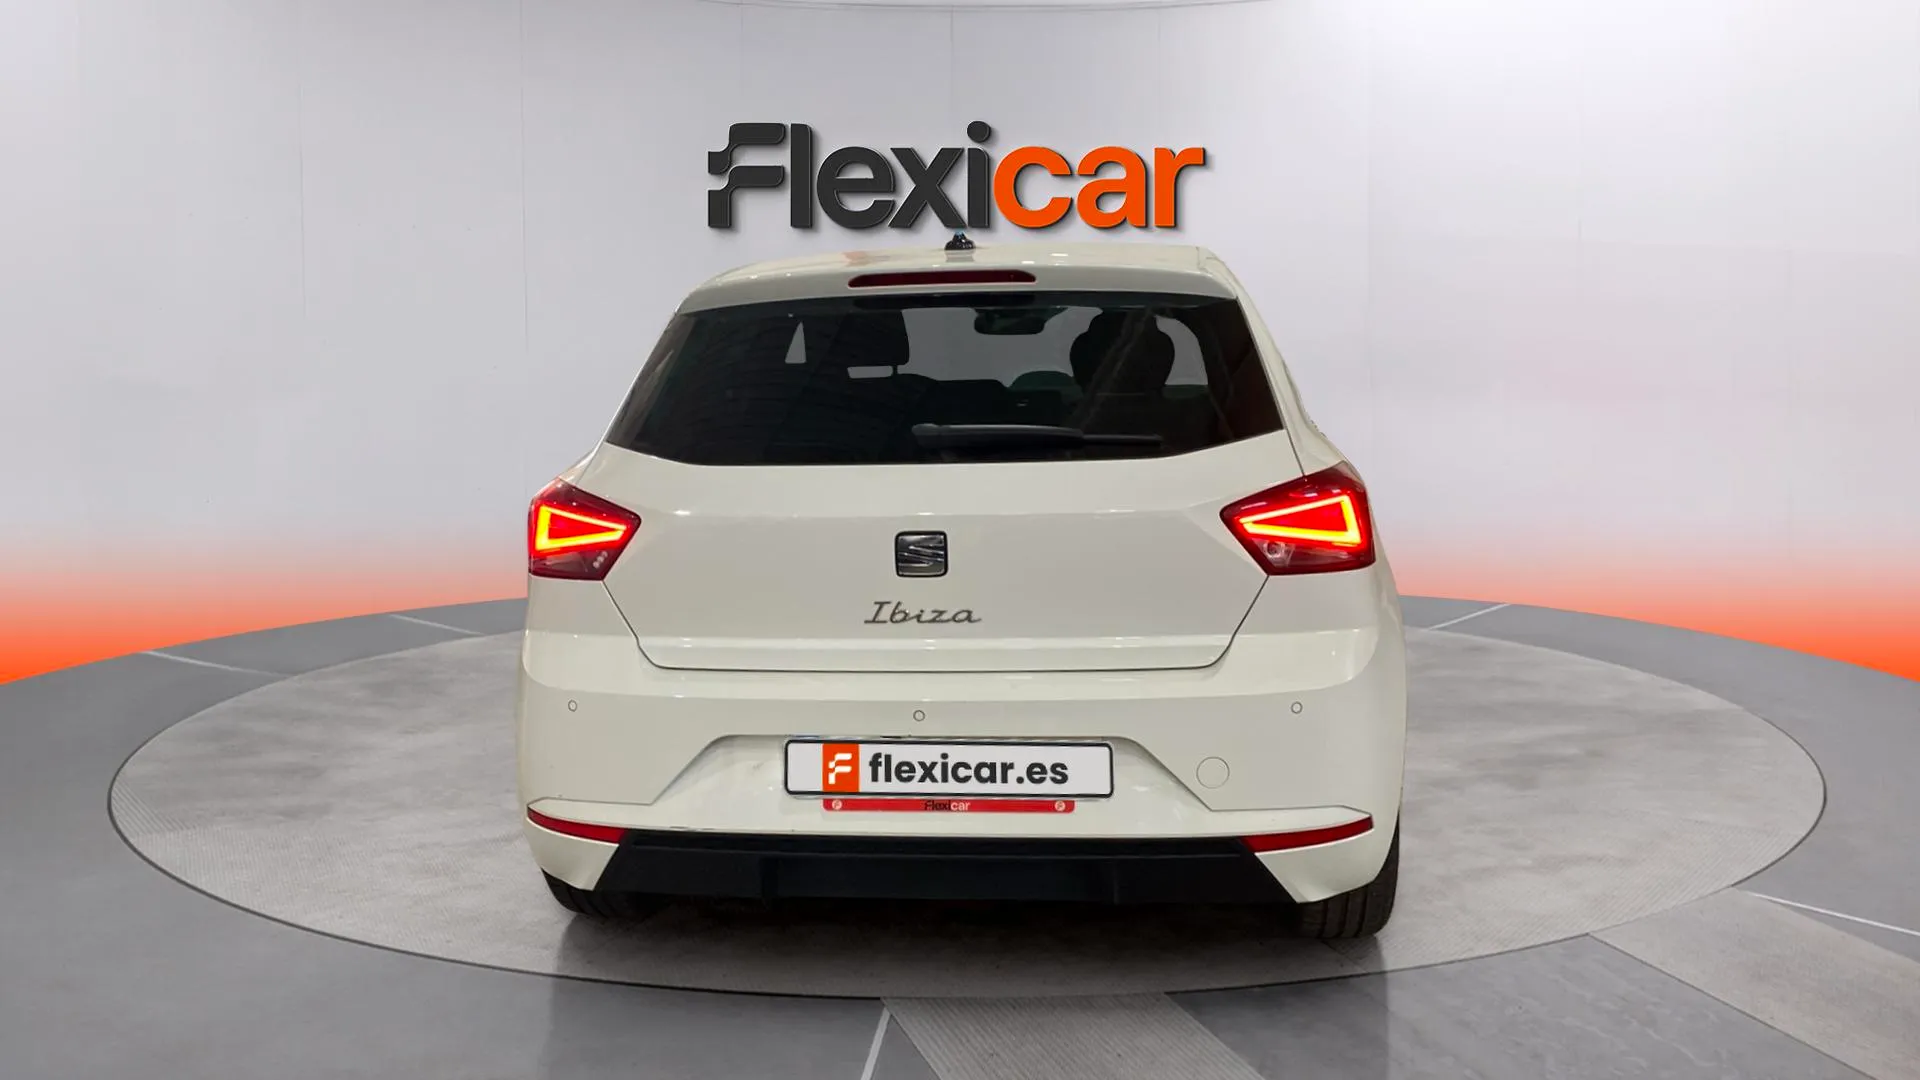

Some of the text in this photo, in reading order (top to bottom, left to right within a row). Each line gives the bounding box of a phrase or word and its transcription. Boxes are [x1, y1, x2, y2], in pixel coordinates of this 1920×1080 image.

[708, 120, 1205, 228] Flexicar
[863, 600, 982, 624] Ibiza
[869, 752, 1069, 784] flexicar.es
